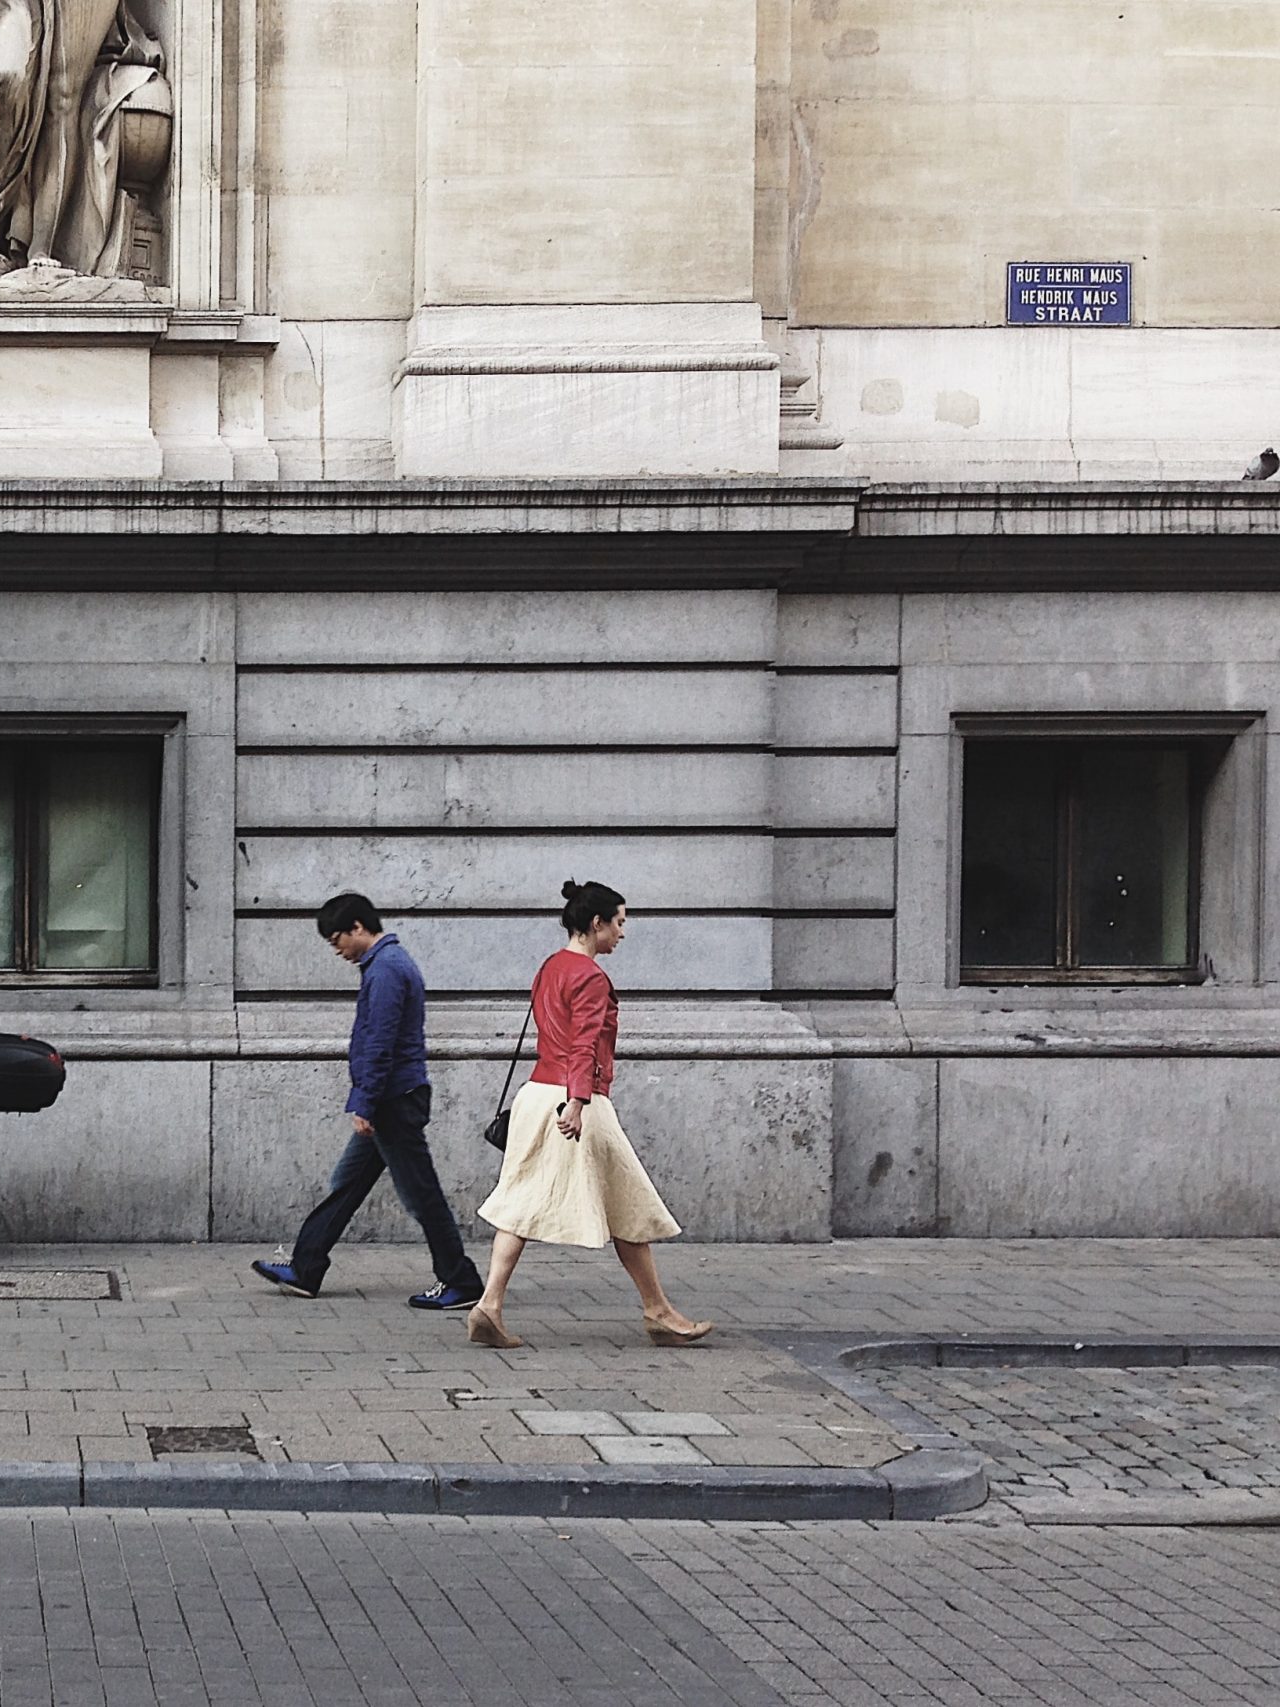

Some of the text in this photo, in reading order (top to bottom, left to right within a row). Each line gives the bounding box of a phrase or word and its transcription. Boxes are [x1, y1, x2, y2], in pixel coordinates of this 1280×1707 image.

[1016, 268, 1123, 283] RUE HENRI MAUS
[1021, 290, 1118, 305] HENDRIK MAUS
[1035, 307, 1103, 321] STRAAT
